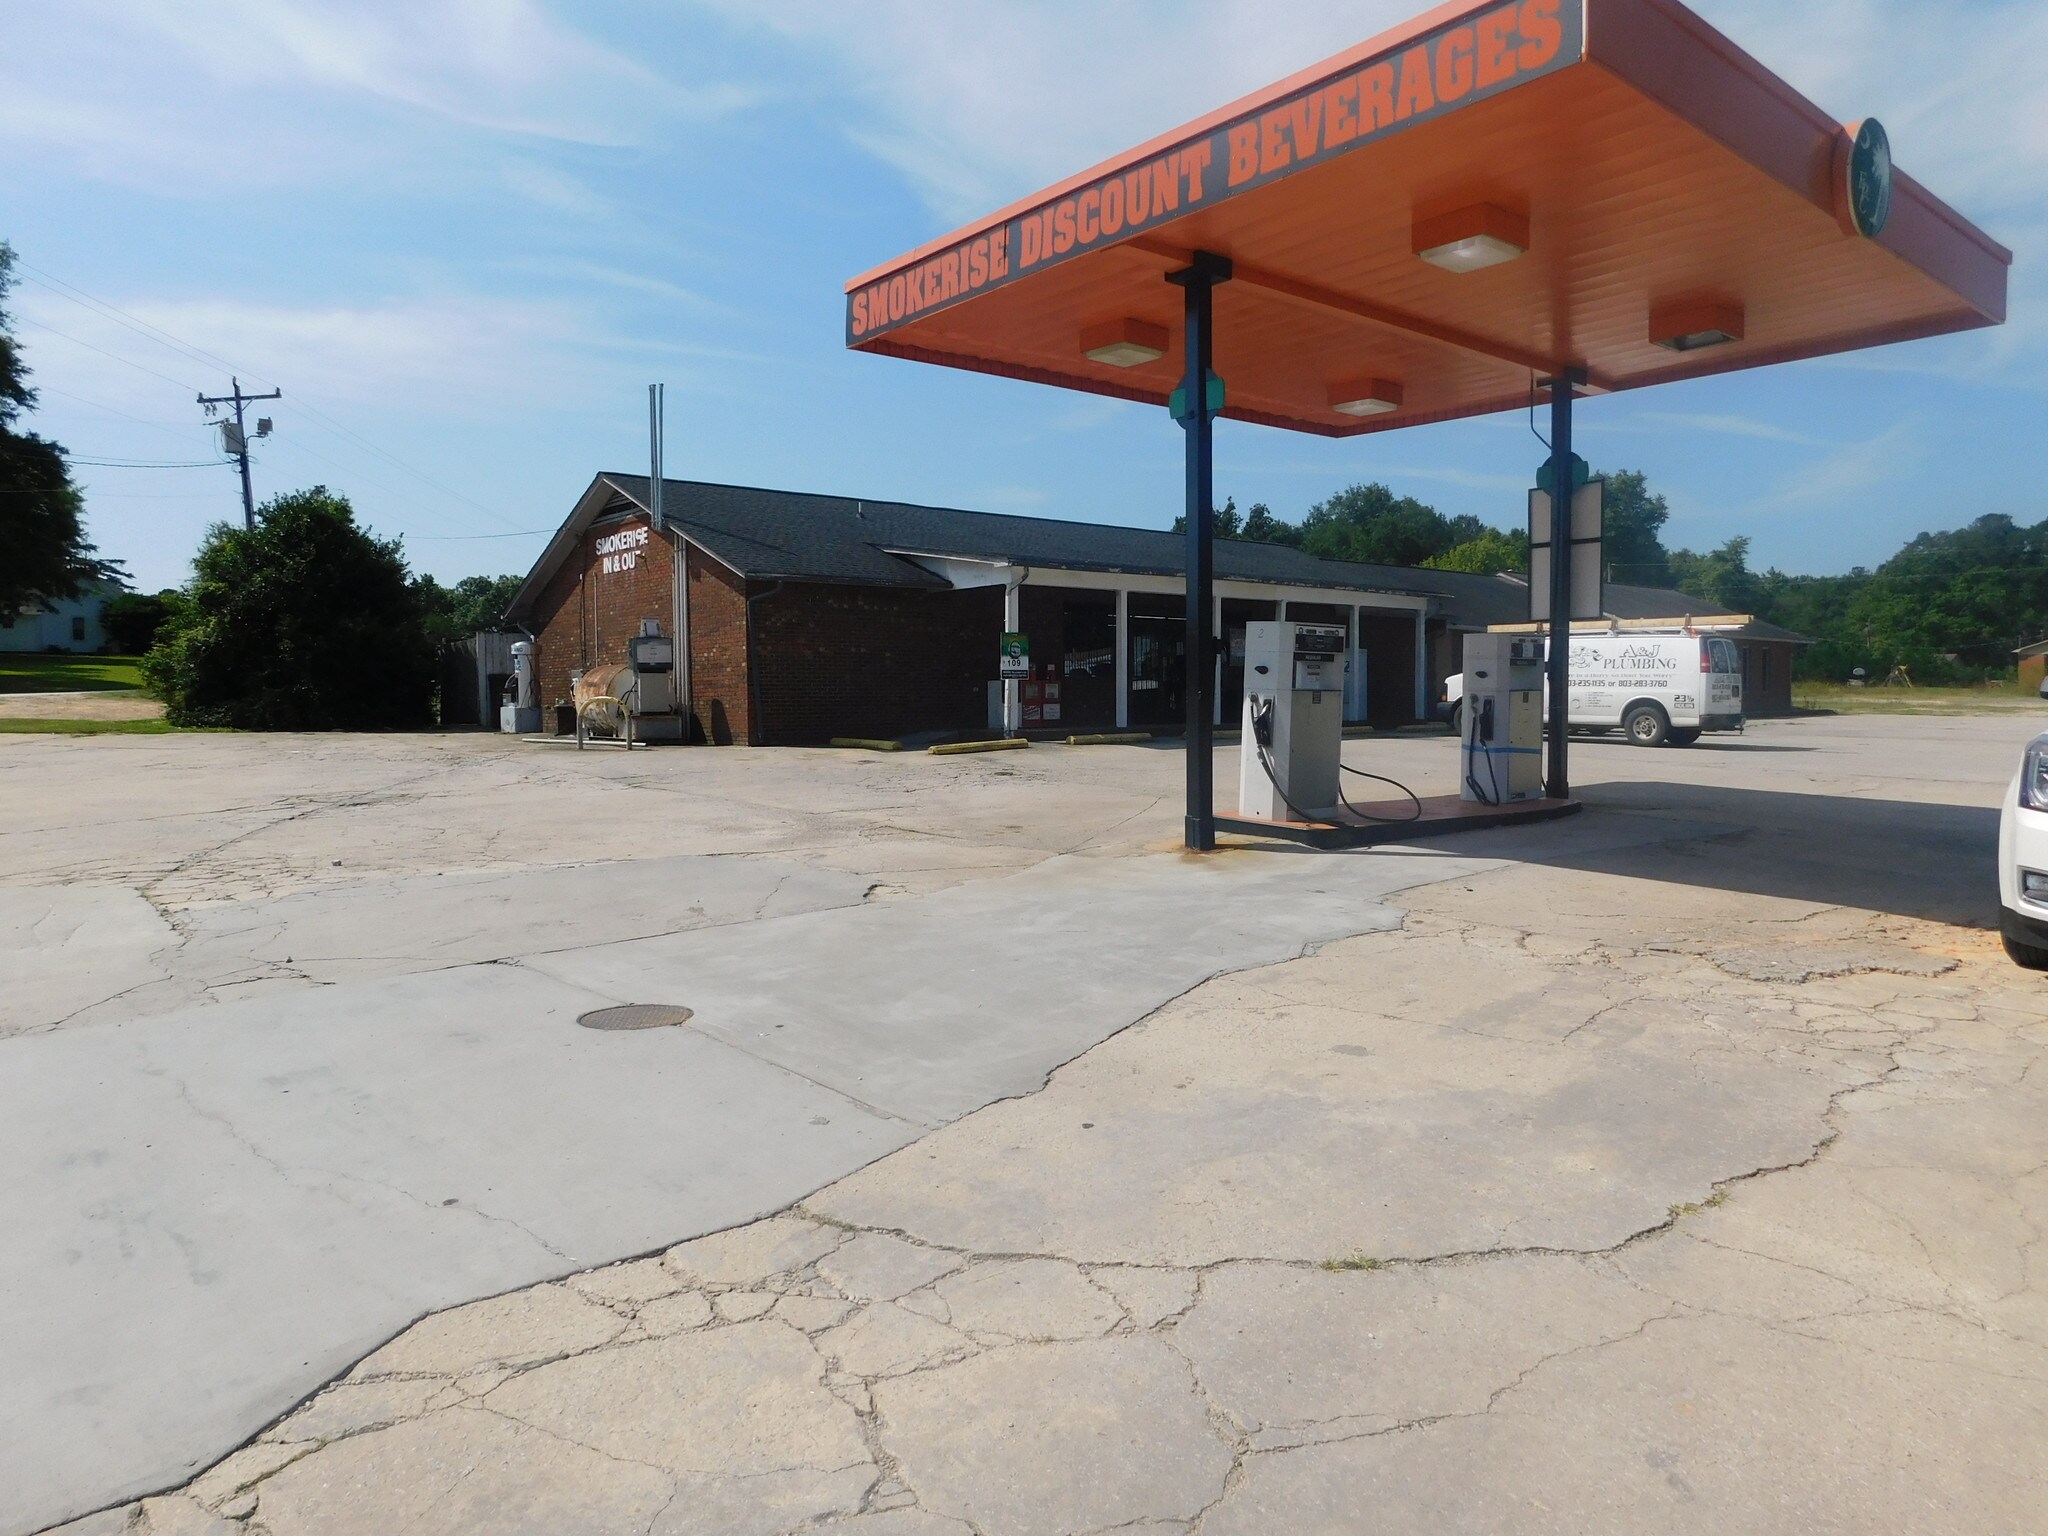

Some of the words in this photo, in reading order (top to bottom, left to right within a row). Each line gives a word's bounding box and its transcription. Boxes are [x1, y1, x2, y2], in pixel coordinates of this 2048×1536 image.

[852, 225, 1009, 336] SMOKERISE
[1020, 138, 1212, 269] DISCOUNT
[1228, 0, 1562, 188] BEVERAGES
[595, 526, 649, 556] SMOKERISE
[603, 557, 613, 574] IN
[613, 555, 621, 572] &
[1619, 644, 1662, 658] A&J
[1603, 658, 1677, 670] PLUMBING
[1568, 680, 1606, 688] 03-235-1135
[1618, 680, 1668, 688] 803-283-3760
